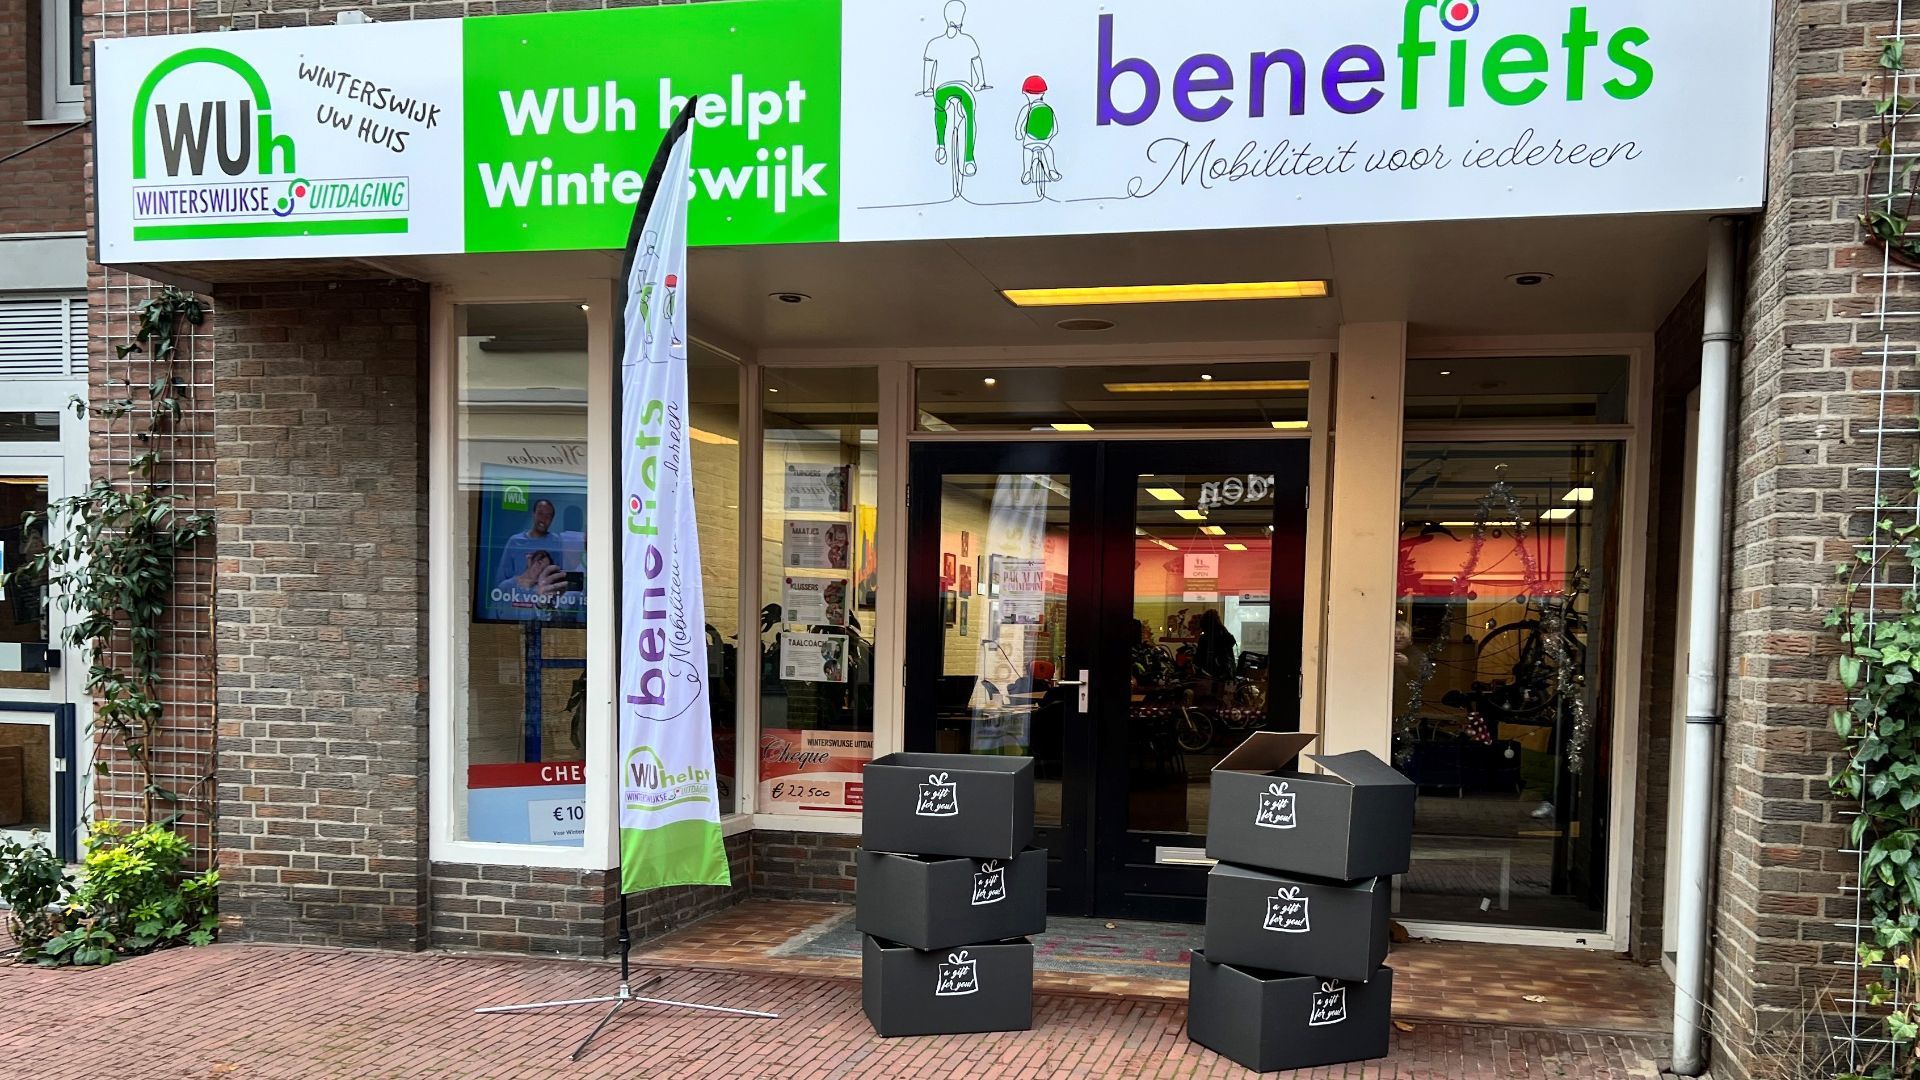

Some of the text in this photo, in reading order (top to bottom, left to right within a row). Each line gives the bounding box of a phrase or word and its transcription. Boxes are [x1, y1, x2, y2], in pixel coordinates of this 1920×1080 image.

[1096, 0, 1654, 126] benefiets
[299, 61, 441, 129] WINTERSWIJK
[498, 74, 806, 140] WUh helpt
[317, 104, 410, 153] UW HUIS
[155, 99, 296, 177] WUh
[1127, 128, 1642, 198] Mobiliteit voor iedereen
[478, 145, 828, 213] Winteswijk
[136, 182, 404, 215] WINTERSWIJKSE UITDAGING
[490, 588, 519, 602] Ook
[523, 593, 553, 604] voor
[555, 590, 576, 609] jou
[762, 734, 829, 770] Cheque
[541, 765, 586, 782] CHE
[931, 788, 950, 800] gift
[921, 799, 934, 811] for
[1270, 798, 1289, 811] gift
[552, 806, 564, 821] €
[1260, 809, 1274, 822] for
[984, 873, 999, 888] gift
[976, 888, 987, 900] for
[1280, 902, 1301, 915] gift
[1269, 913, 1284, 926] for
[950, 965, 970, 979] gift
[941, 978, 954, 991] for
[1322, 993, 1340, 1009] gift
[1314, 1008, 1326, 1021] for
